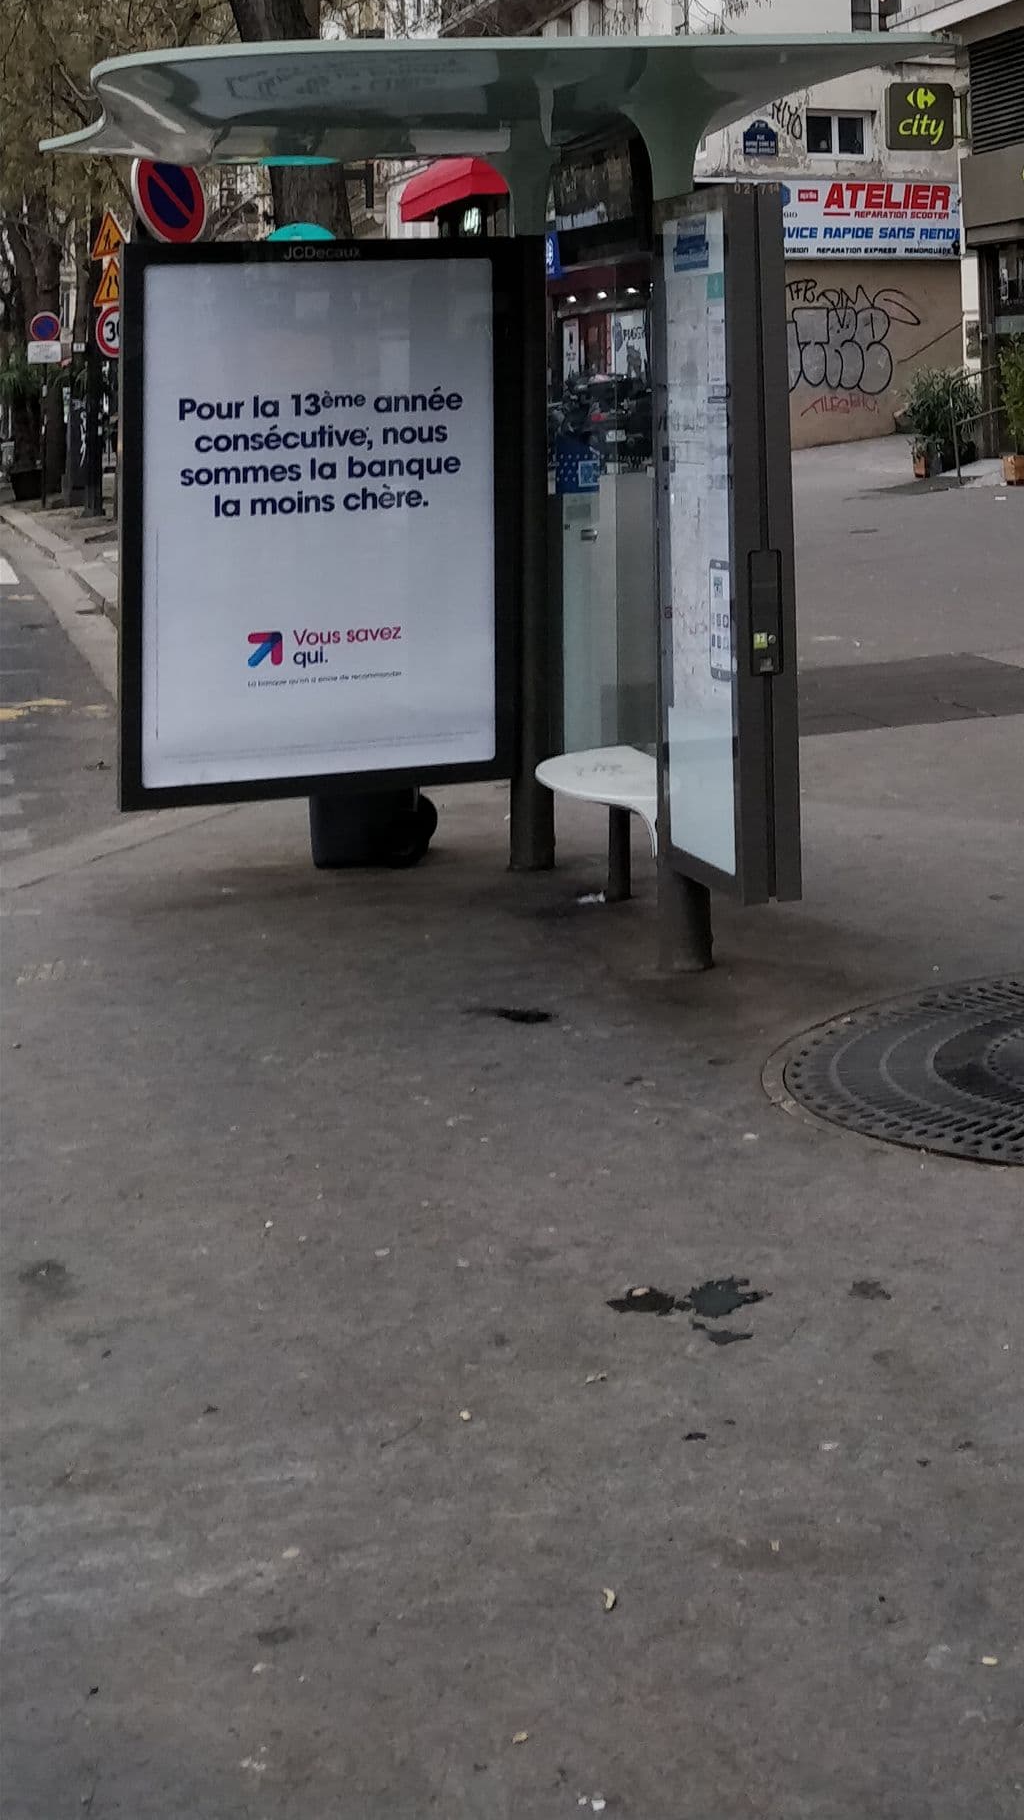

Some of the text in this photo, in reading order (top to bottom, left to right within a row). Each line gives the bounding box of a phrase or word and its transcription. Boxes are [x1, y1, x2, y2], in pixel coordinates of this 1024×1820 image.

[899, 113, 945, 145] city
[824, 183, 951, 210] ATELIER
[910, 211, 949, 220] SCOOTER
[783, 227, 818, 239] VICE
[823, 227, 874, 239] RAPIDE
[879, 228, 915, 239] SANS
[284, 246, 360, 260] JCDecaux
[179, 386, 463, 421] Pour la 13ème année
[195, 424, 448, 453] consécutive, nous
[180, 456, 461, 486] sommes la banque
[215, 484, 429, 517] la moins chère.
[293, 626, 402, 645] Vous savez
[293, 646, 328, 668] qui.
